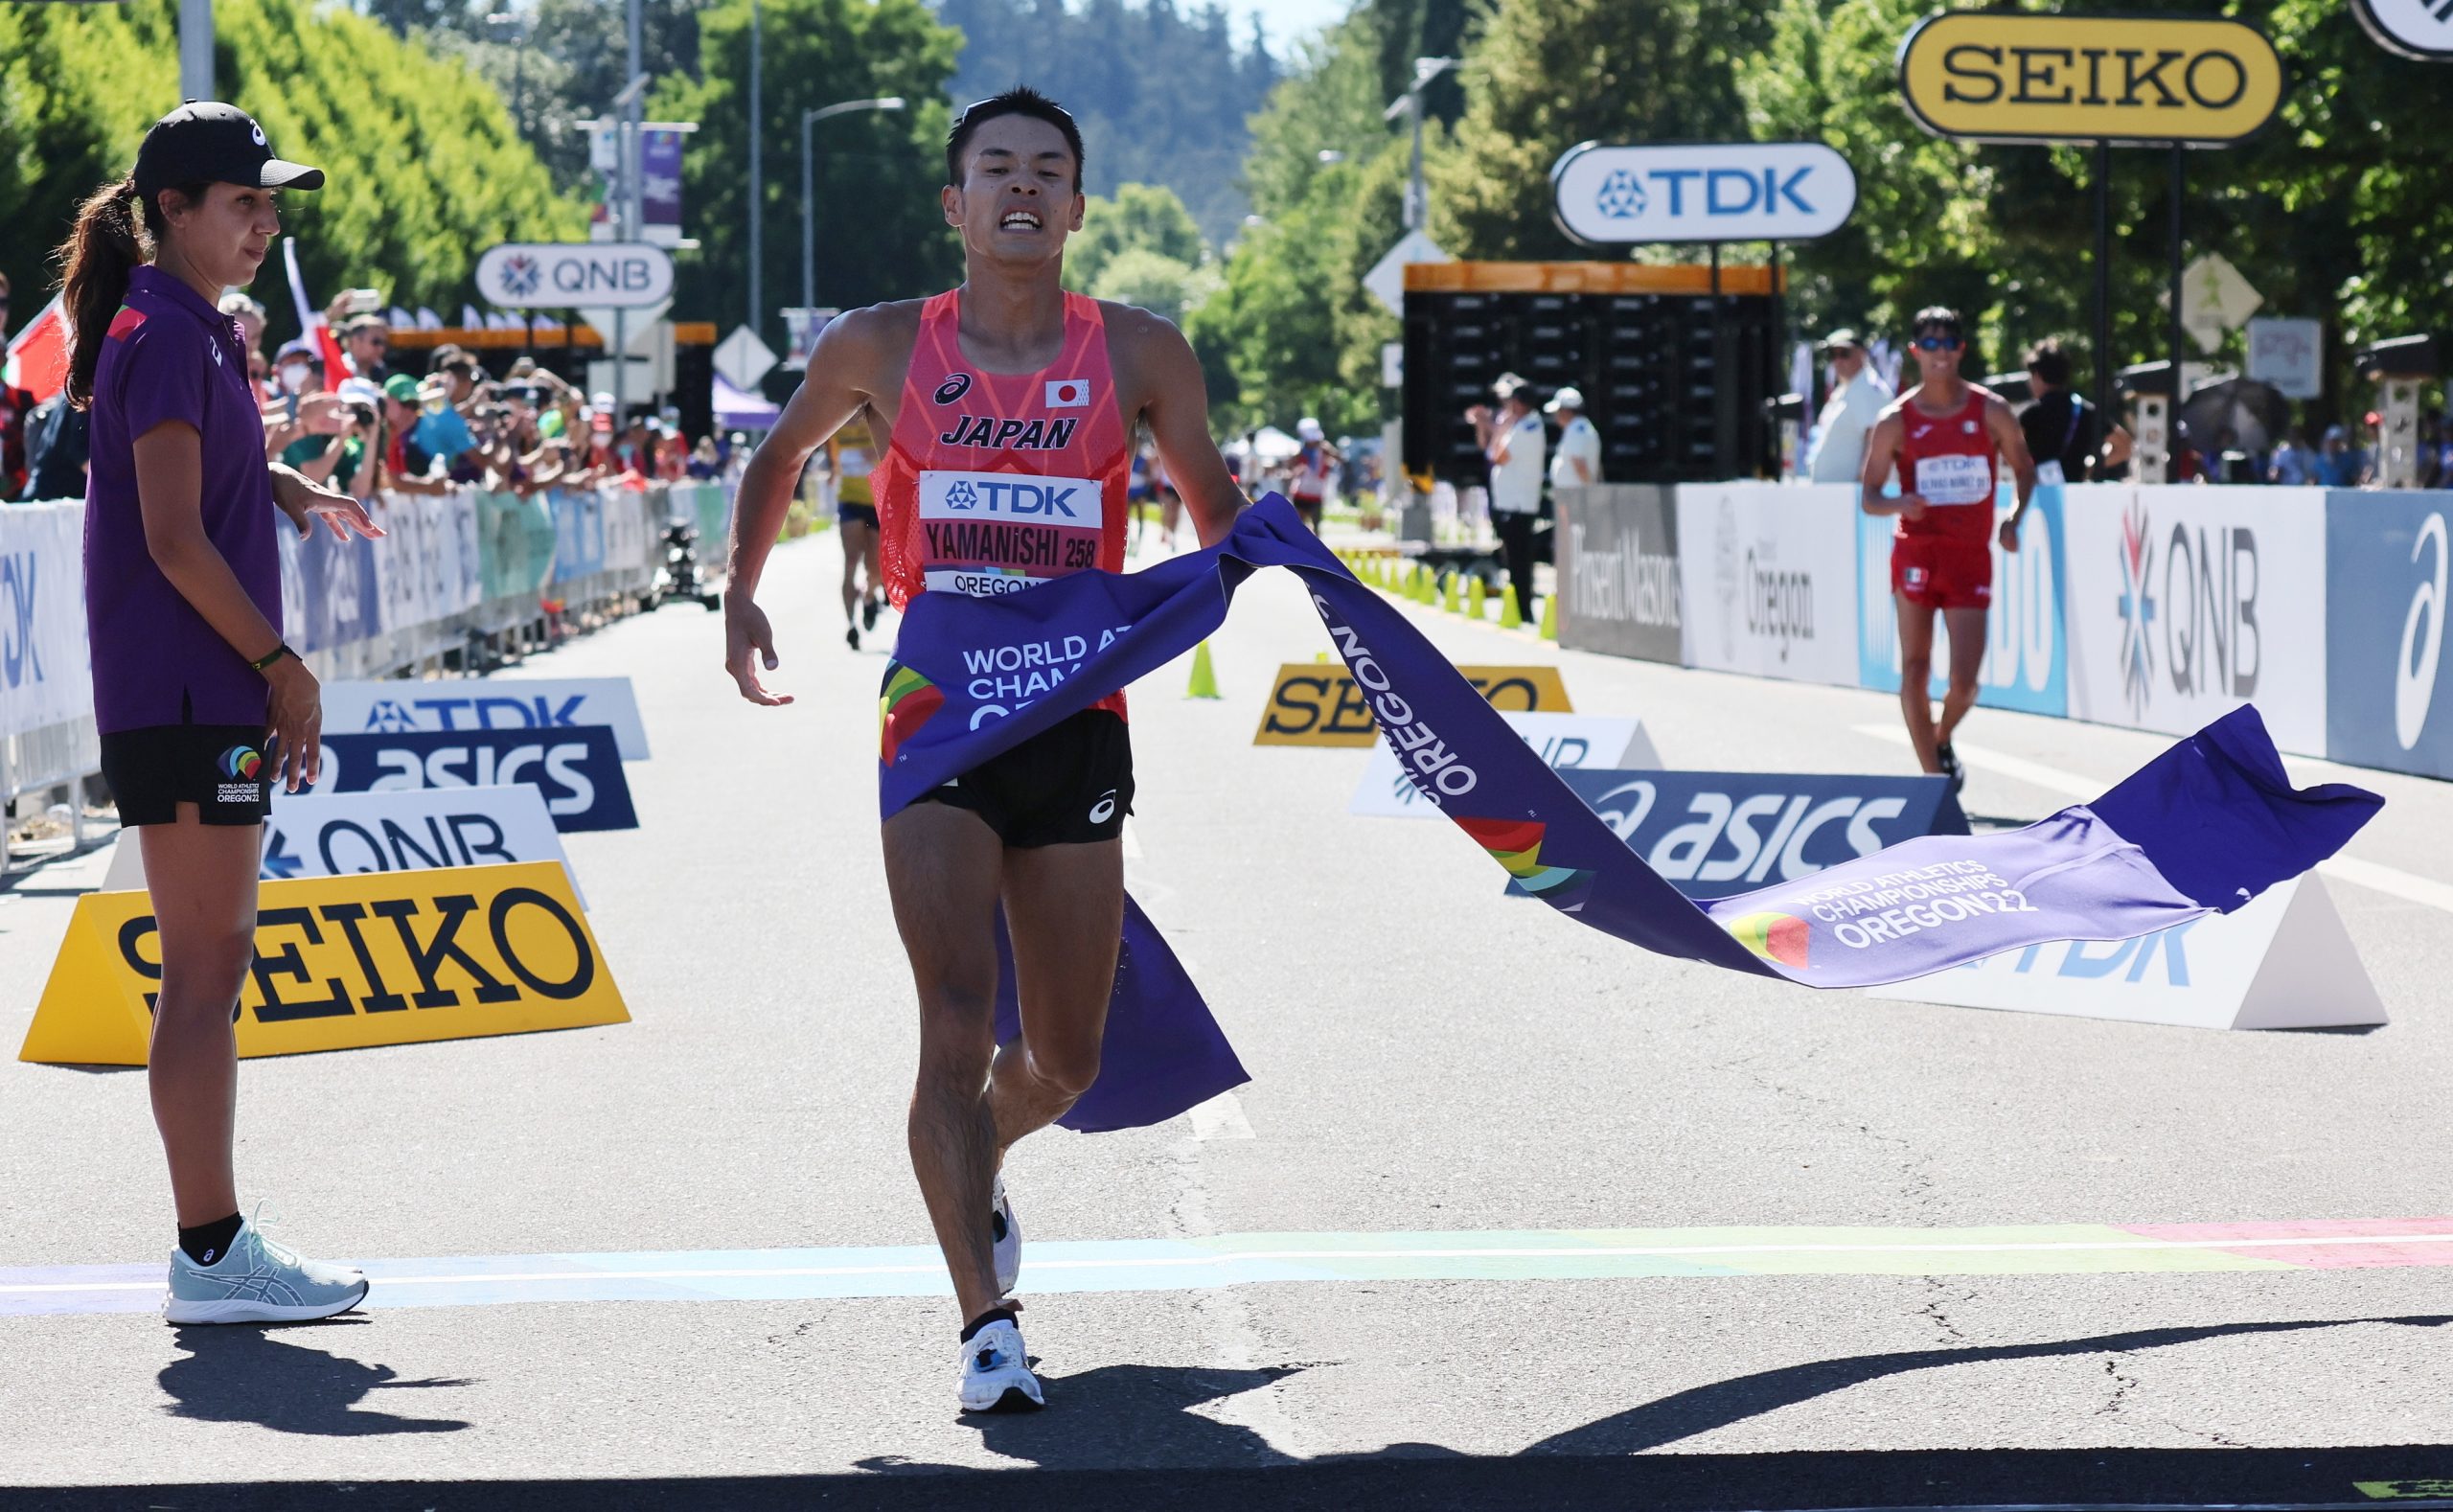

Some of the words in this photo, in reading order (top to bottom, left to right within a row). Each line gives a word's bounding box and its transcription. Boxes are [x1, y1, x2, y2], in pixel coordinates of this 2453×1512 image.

[1943, 44, 2248, 109] SEIKO
[1648, 165, 1817, 217] TDK
[553, 258, 652, 292] QNB
[940, 415, 1079, 450] JAPAN
[977, 481, 1078, 517] TDK
[926, 523, 1059, 566] YAMANISHI
[1065, 538, 1095, 568] 258
[1746, 547, 1814, 663] Oregon
[2166, 522, 2260, 699] QNB
[963, 635, 1087, 675] WORLD
[414, 695, 586, 732] TDK
[318, 814, 518, 874] QNB
[1648, 792, 1908, 882] asics
[1791, 881, 1875, 905] WORLD
[1873, 859, 1987, 887] ATHLETICS
[1812, 873, 2008, 923] CHAMPIONSHIPS
[1834, 889, 2040, 949] OREGON22
